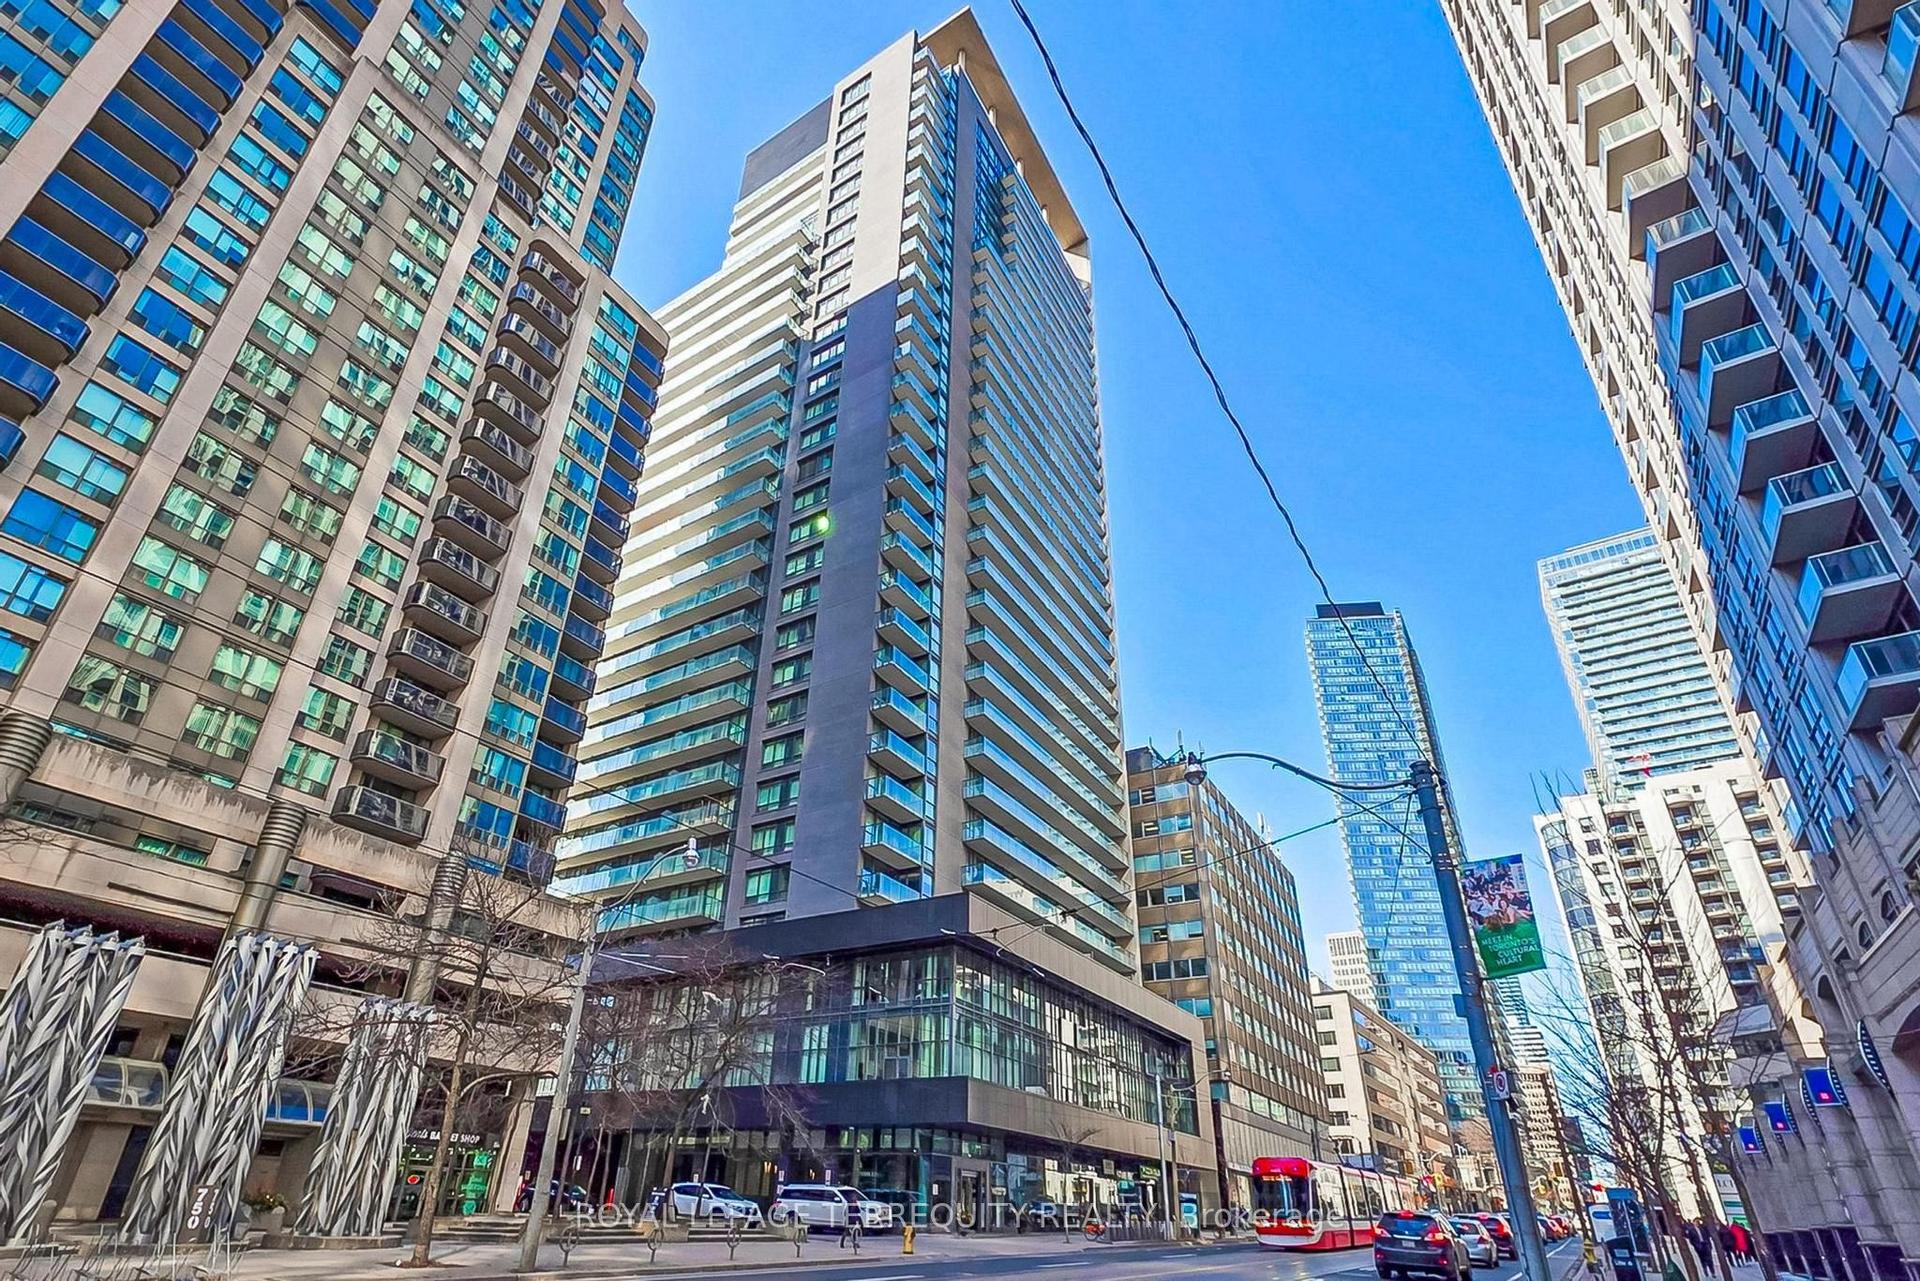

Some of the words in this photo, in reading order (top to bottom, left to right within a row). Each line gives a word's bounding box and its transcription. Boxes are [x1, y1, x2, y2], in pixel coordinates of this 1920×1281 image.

[1481, 936, 1502, 945] MEET
[1497, 944, 1541, 958] CULTURAL
[1496, 955, 1523, 966] HEART
[460, 1133, 481, 1144] SHOP
[187, 1188, 209, 1230] 750
